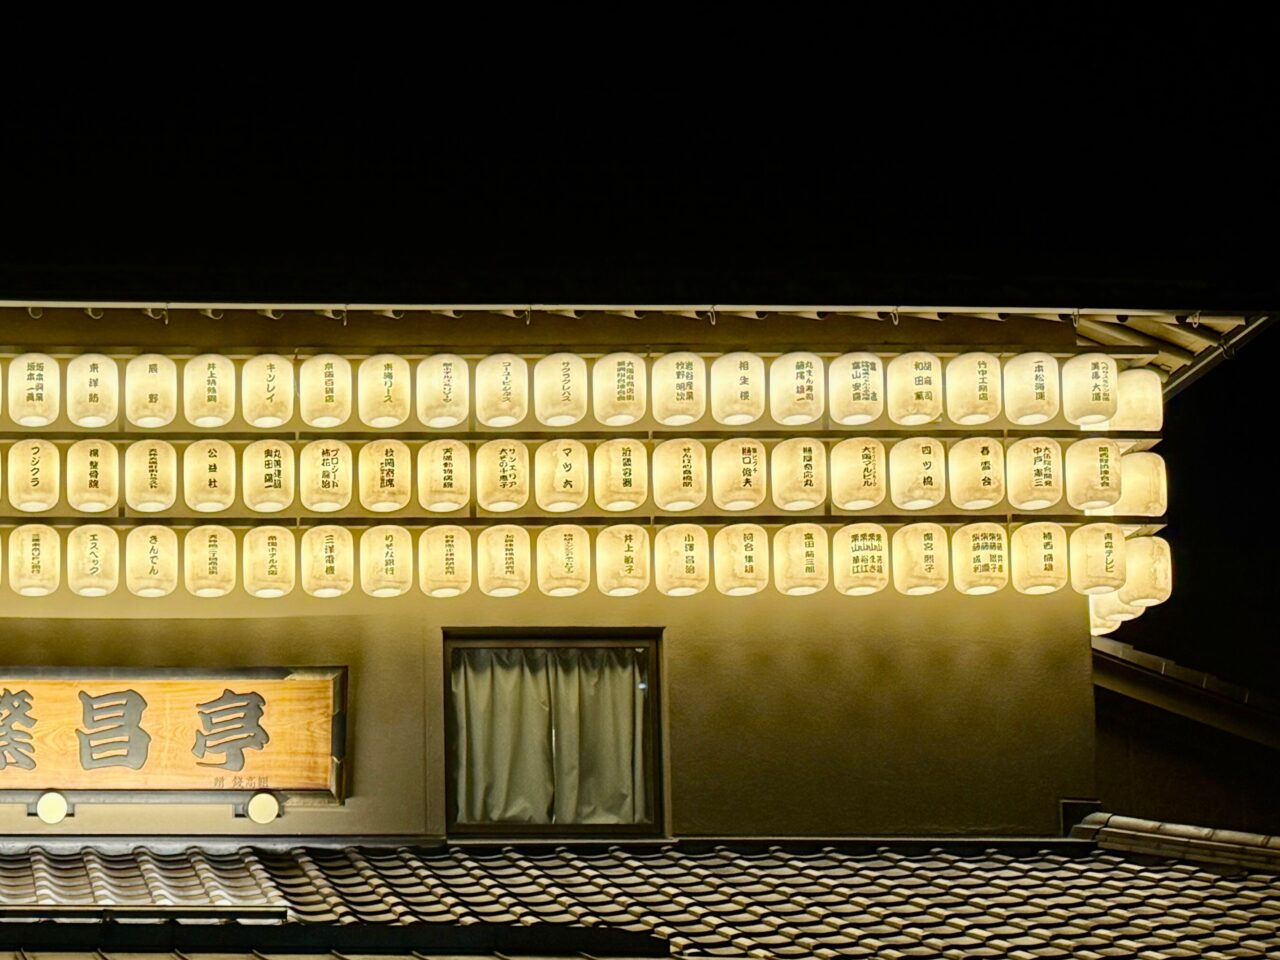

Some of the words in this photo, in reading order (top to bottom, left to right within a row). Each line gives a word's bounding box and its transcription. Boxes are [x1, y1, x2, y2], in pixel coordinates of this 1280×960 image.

[89, 363, 100, 403] 東洋紡
[148, 363, 158, 403] 辰野
[265, 362, 276, 403] キンレイ
[324, 362, 335, 403] 京阪百貨店
[383, 362, 394, 404] 東海リース
[978, 360, 988, 401] 竹中工務店
[1034, 360, 1046, 401] 一本松海運
[30, 446, 40, 487] フジクラ
[207, 448, 218, 489] 公益社
[331, 448, 340, 488] プロシード
[563, 447, 573, 489] マツ六
[622, 447, 633, 488] 近畿容器
[803, 446, 814, 487] 樋屋奇応丸
[862, 446, 872, 487] 大阪マルビル
[922, 446, 933, 487] 四ツ橋
[325, 535, 335, 576] 三洋電機
[385, 535, 395, 575] りそな銀行
